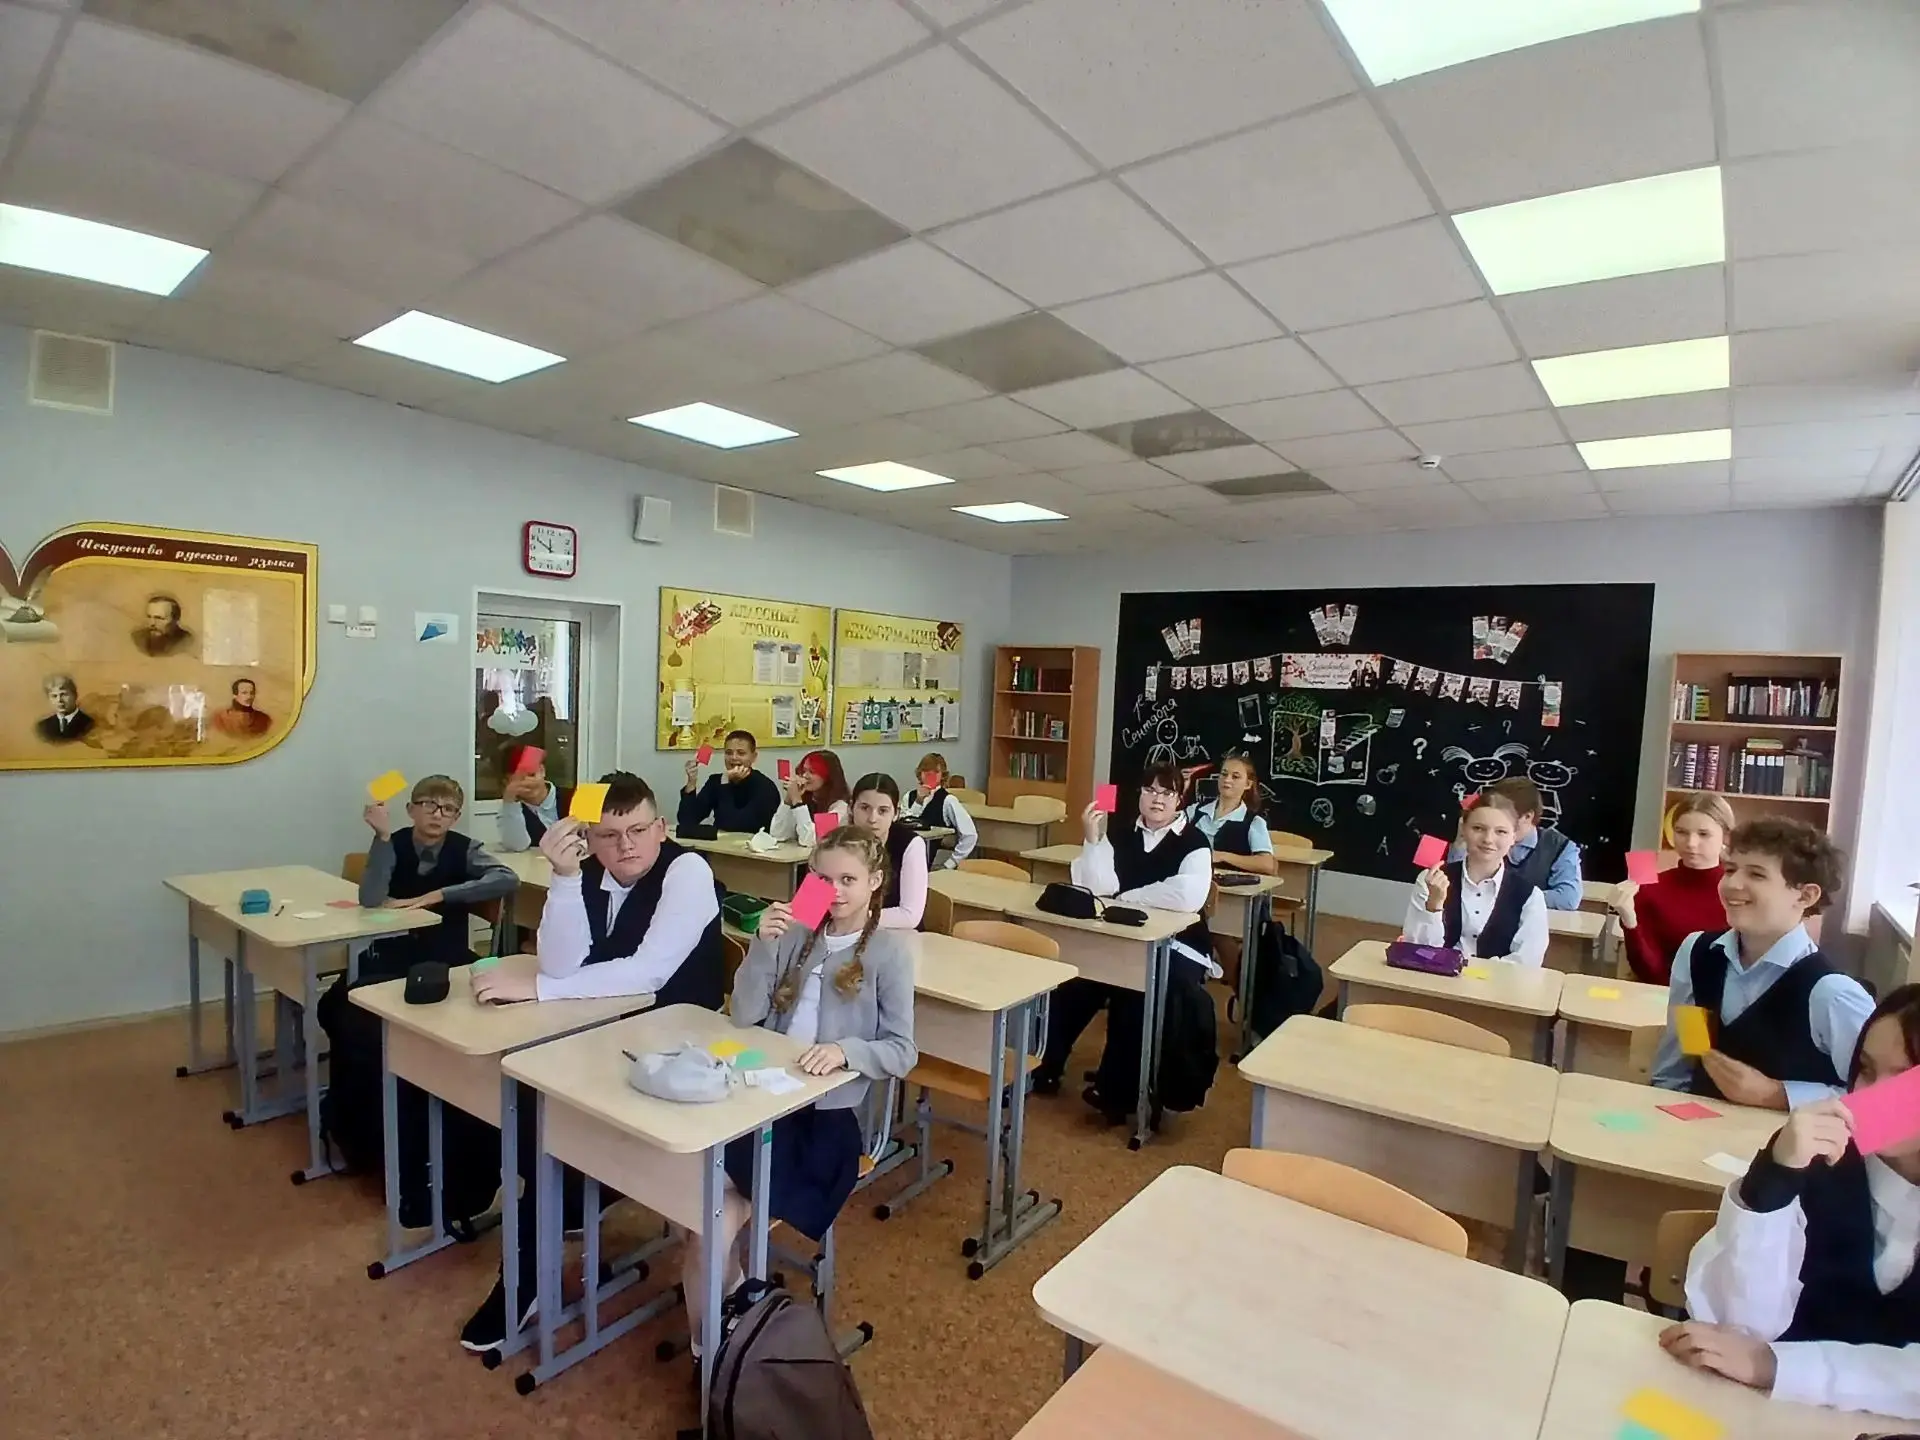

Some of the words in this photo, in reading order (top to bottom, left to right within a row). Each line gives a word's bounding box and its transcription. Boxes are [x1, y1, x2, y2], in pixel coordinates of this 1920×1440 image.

[76, 538, 164, 556] Искусство
[175, 549, 238, 562] русского
[247, 556, 296, 568] языка
[1122, 698, 1178, 749] Сентября
